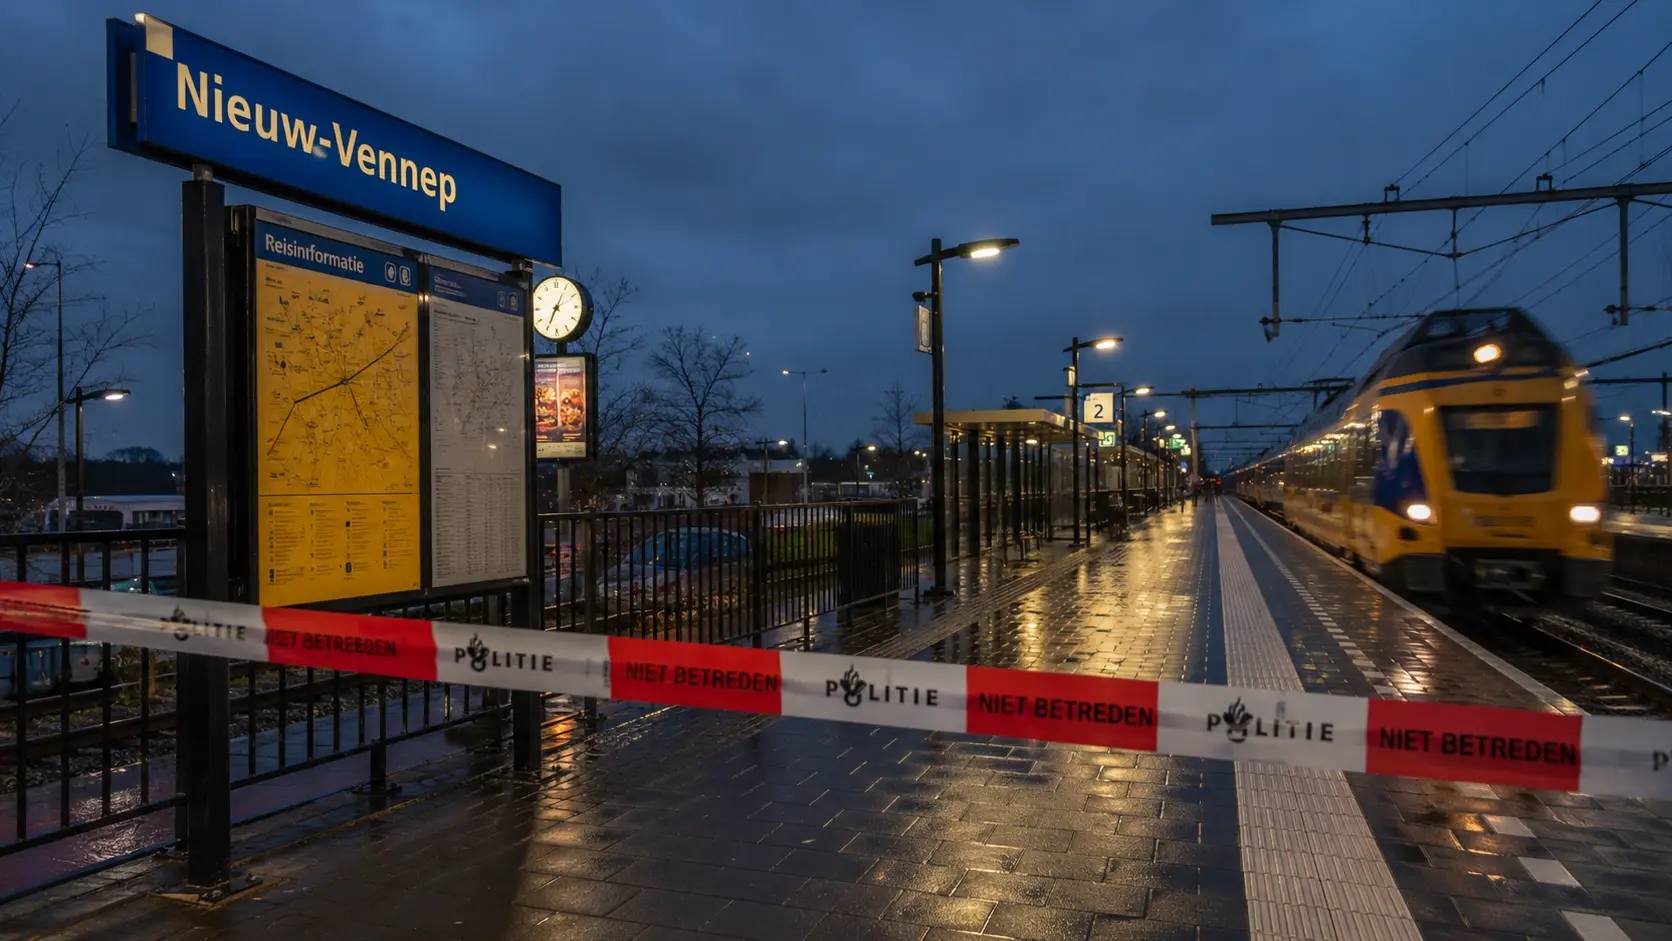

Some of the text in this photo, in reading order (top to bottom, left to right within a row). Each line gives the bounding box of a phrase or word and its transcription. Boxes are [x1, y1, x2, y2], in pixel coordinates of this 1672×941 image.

[177, 62, 457, 212] Nieuw-Vennep
[1094, 404, 1104, 419] 2
[455, 632, 554, 672] POLITIE
[625, 661, 779, 693] NIET BETREDEN
[825, 664, 939, 707] POLITIE
[978, 692, 1155, 728] NIET BETREDEN
[1206, 697, 1335, 743] POLITIE
[1379, 726, 1577, 765] NIET BETREDEN
